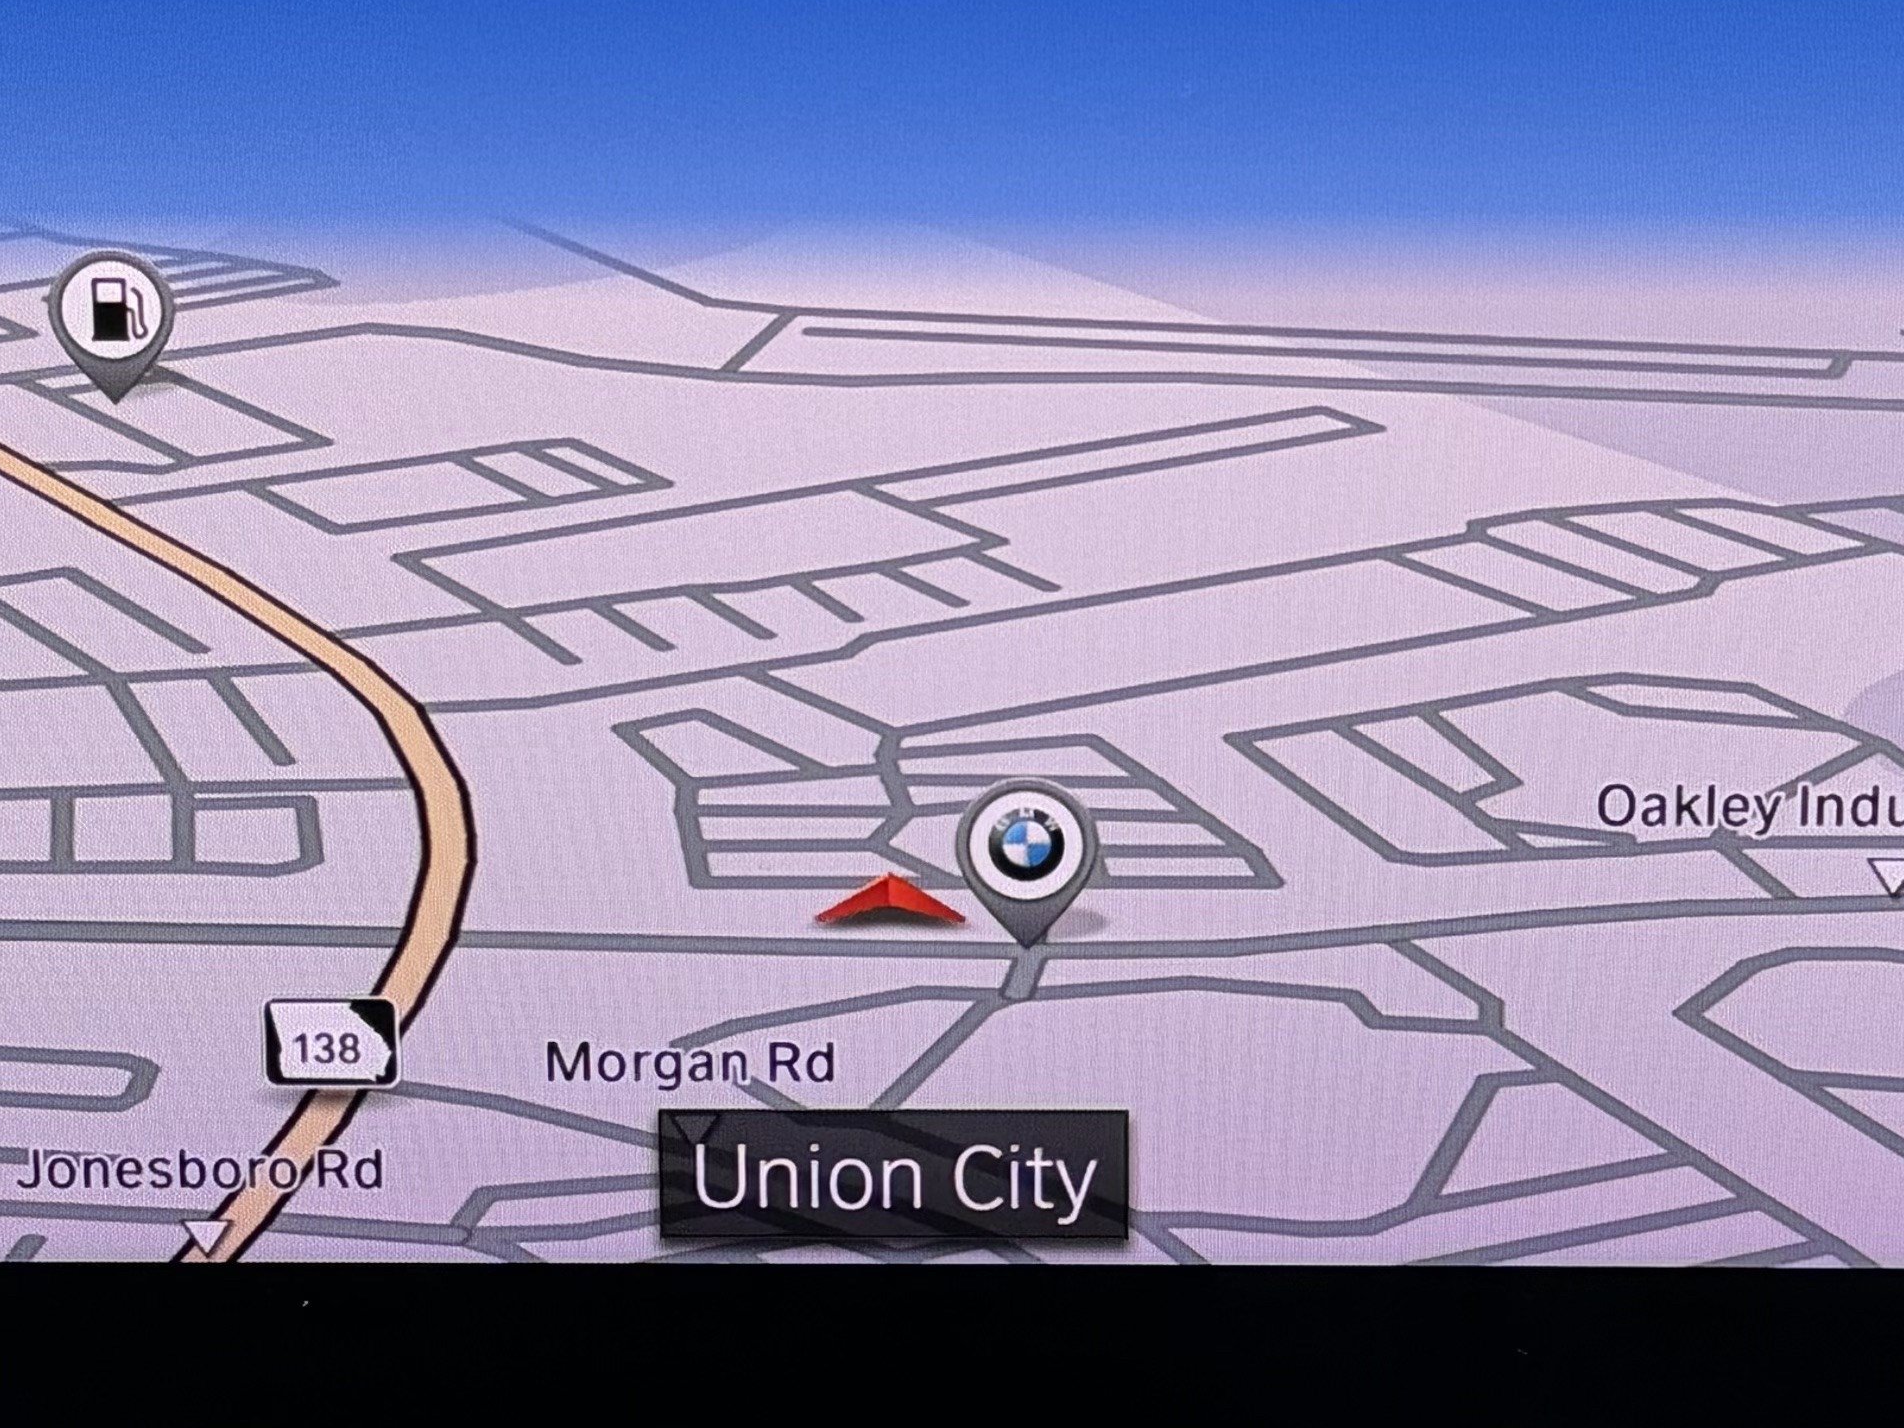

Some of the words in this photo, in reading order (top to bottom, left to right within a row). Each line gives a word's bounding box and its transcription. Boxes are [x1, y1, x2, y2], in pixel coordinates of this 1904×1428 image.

[1598, 784, 1781, 835] Oakley
[294, 1031, 362, 1065] 138
[546, 1041, 748, 1091] Morgan
[768, 1042, 835, 1084] Rd
[17, 1148, 299, 1191] Jonesboro
[316, 1149, 383, 1190] Rd
[695, 1143, 923, 1212] Union
[954, 1144, 1099, 1225] City
